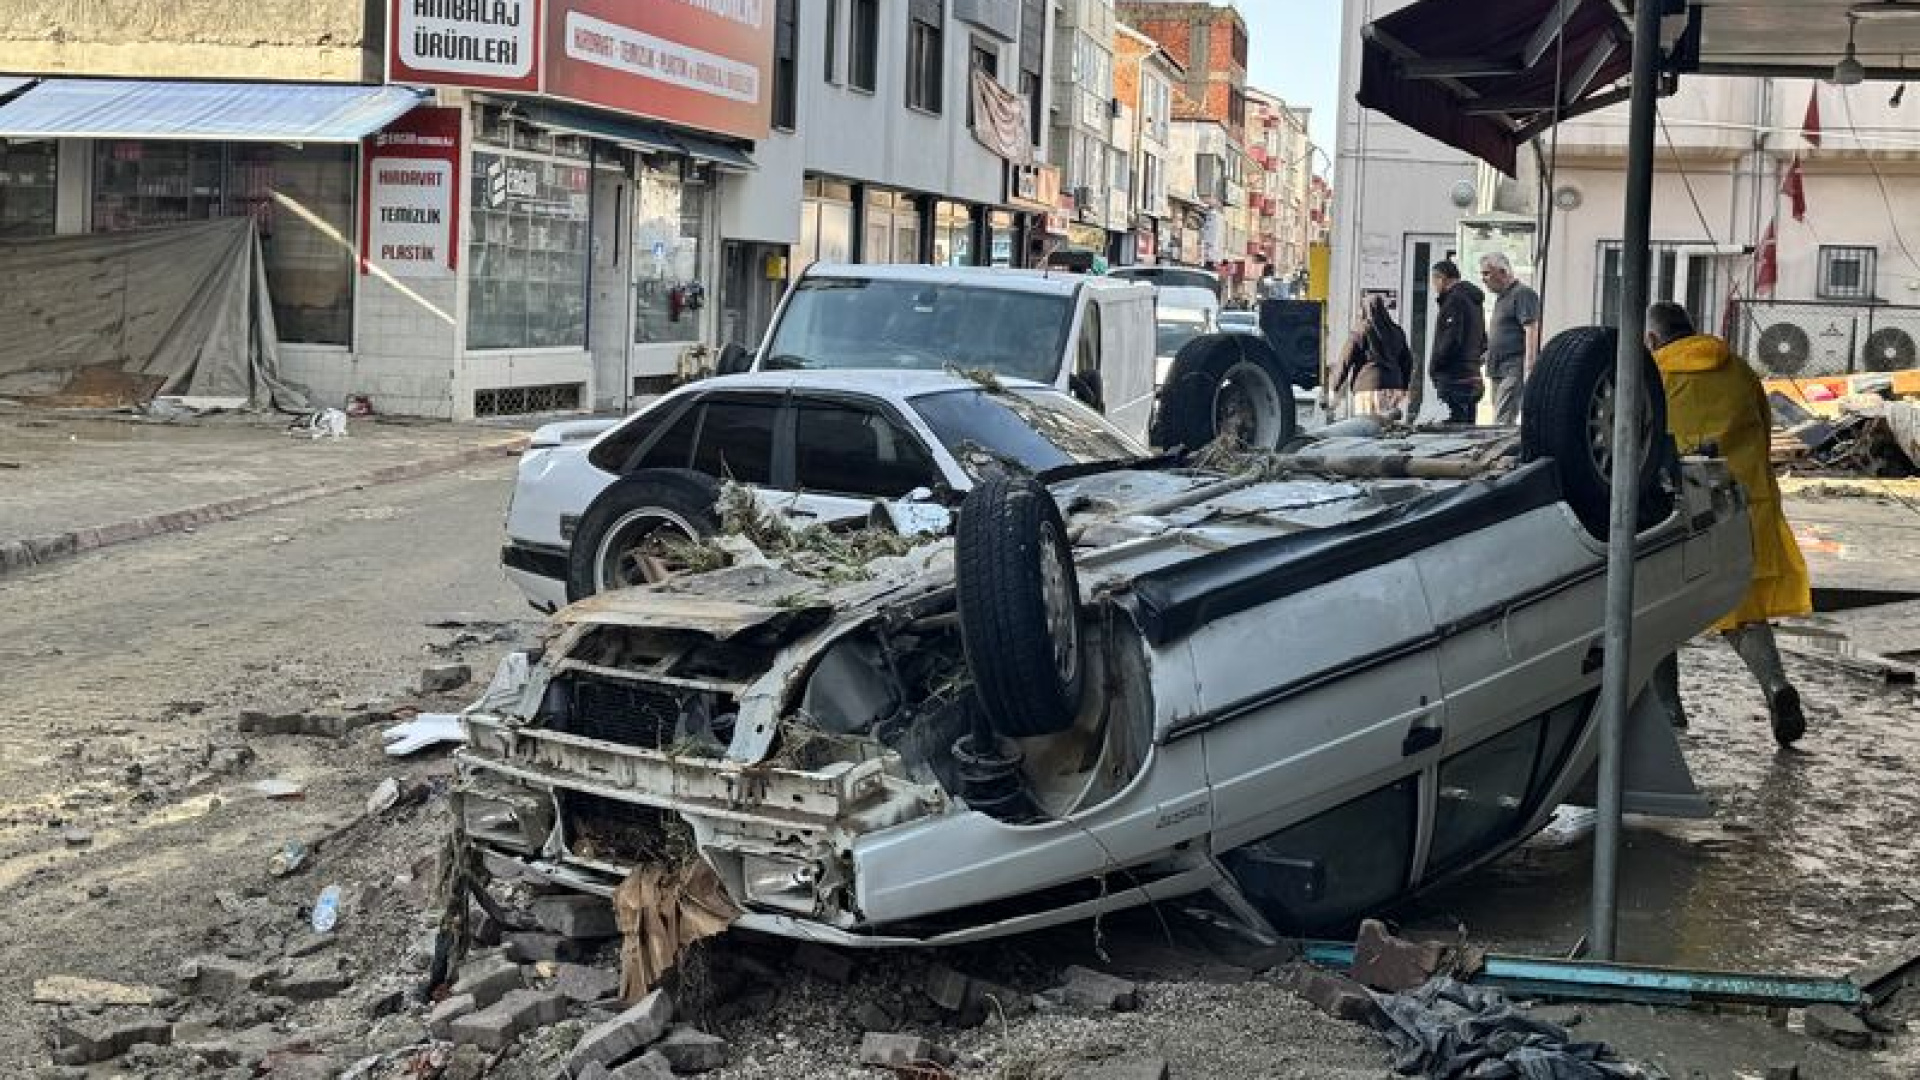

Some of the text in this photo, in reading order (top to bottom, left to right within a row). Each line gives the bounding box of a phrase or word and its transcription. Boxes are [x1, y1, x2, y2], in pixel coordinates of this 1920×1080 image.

[413, 0, 519, 26] AMBALAJ
[415, 26, 518, 65] ÜRÜNLERİ
[379, 169, 443, 187] HIRDAVAT
[381, 204, 441, 223] TEMİZLİK
[381, 242, 436, 261] PLASTİK
